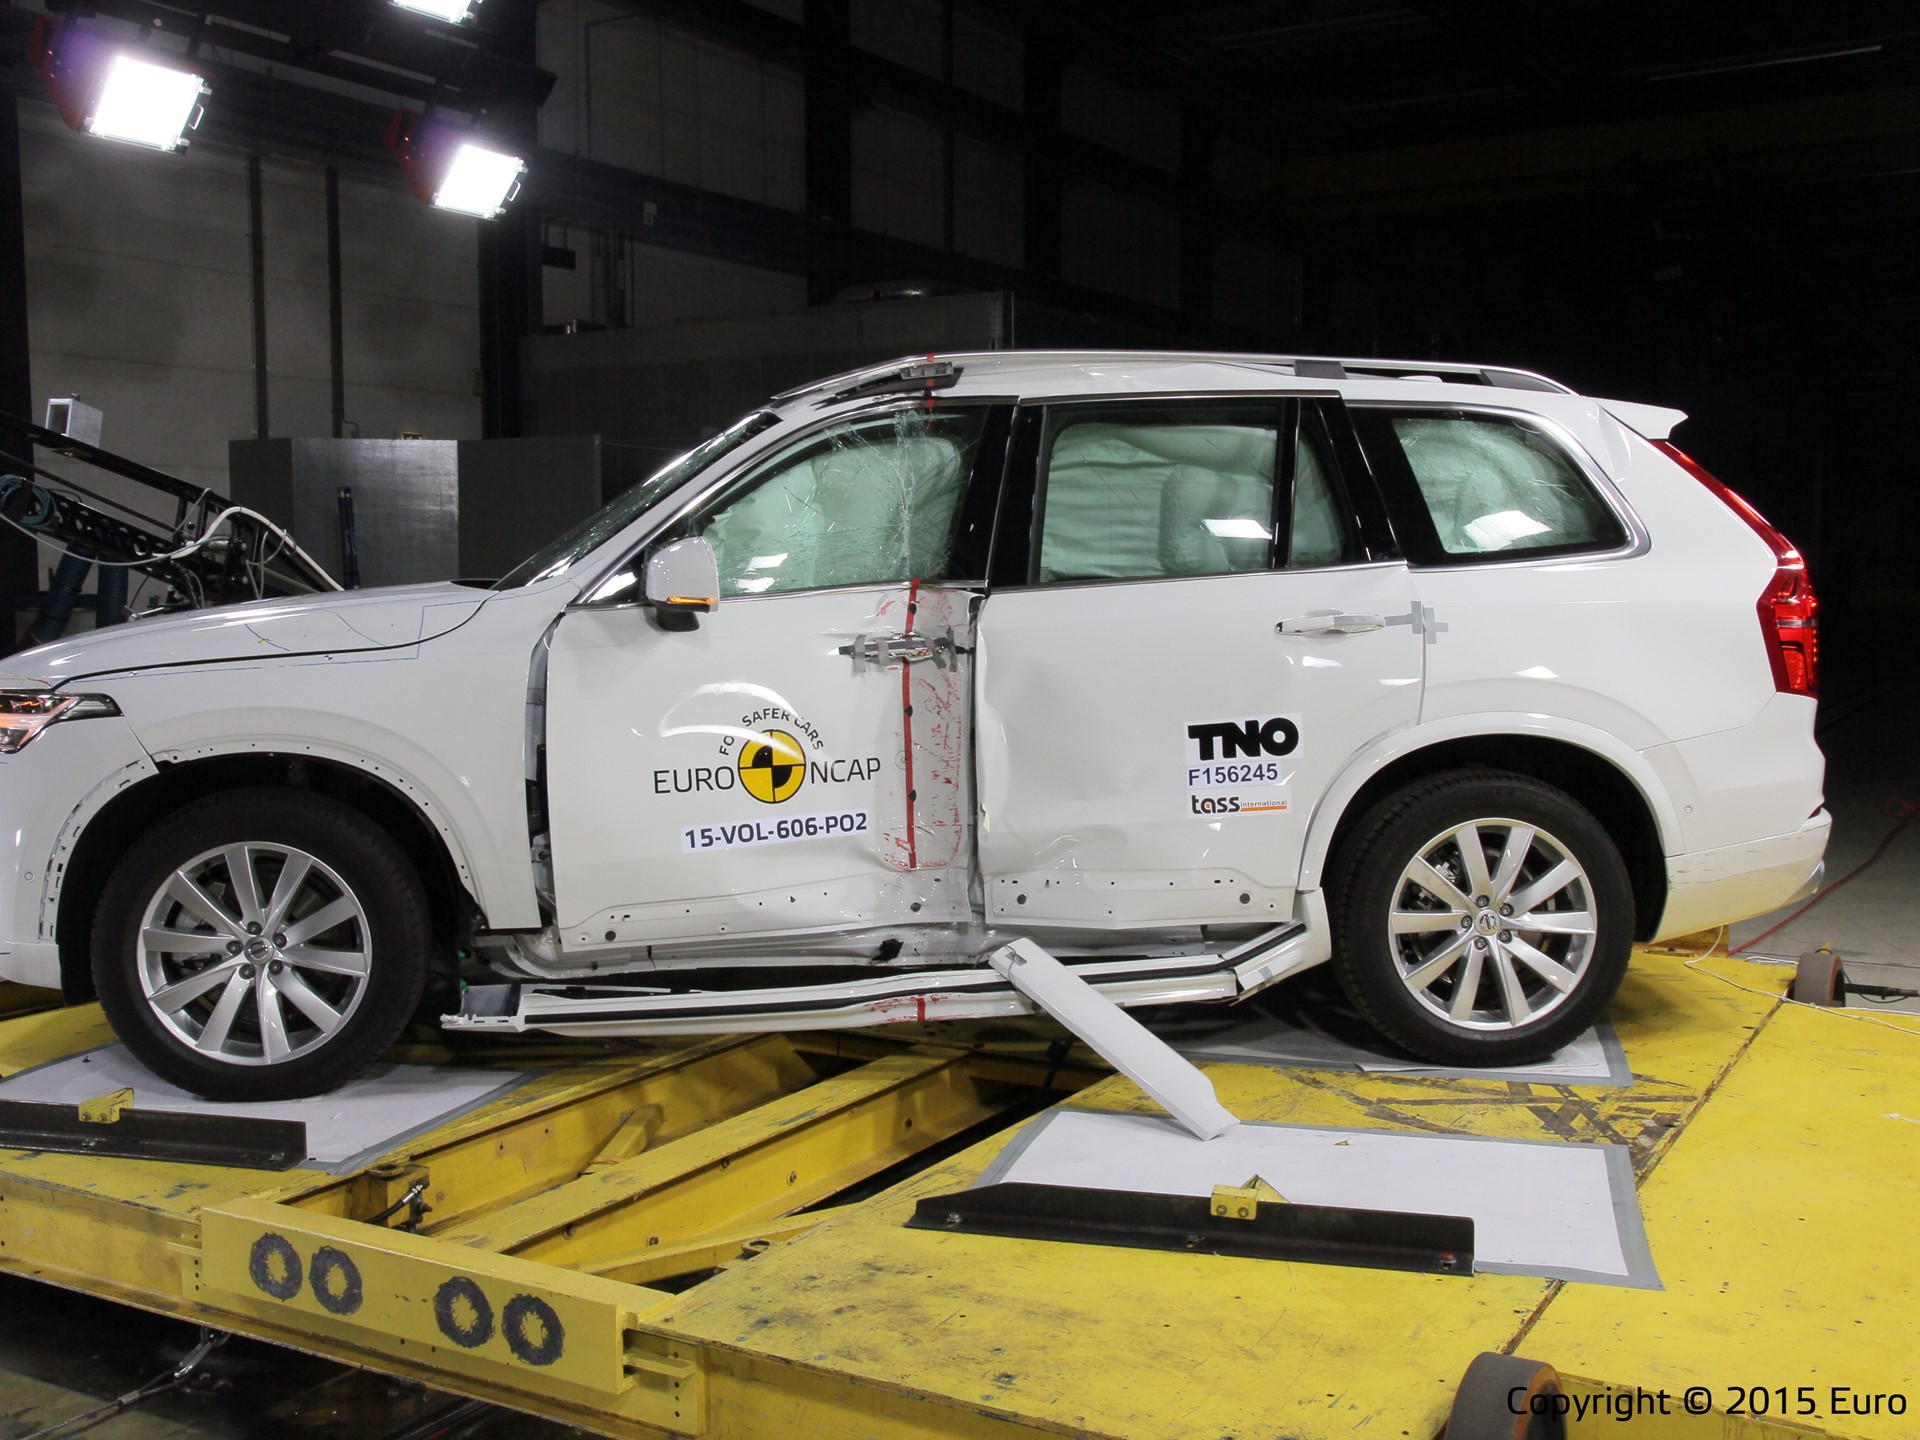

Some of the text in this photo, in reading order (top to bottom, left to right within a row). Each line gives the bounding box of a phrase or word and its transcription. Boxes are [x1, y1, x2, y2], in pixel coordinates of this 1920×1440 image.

[1187, 717, 1299, 761] TNO
[653, 757, 881, 794] EURO NCAP
[1188, 763, 1278, 786] F156245
[1191, 795, 1240, 815] tass
